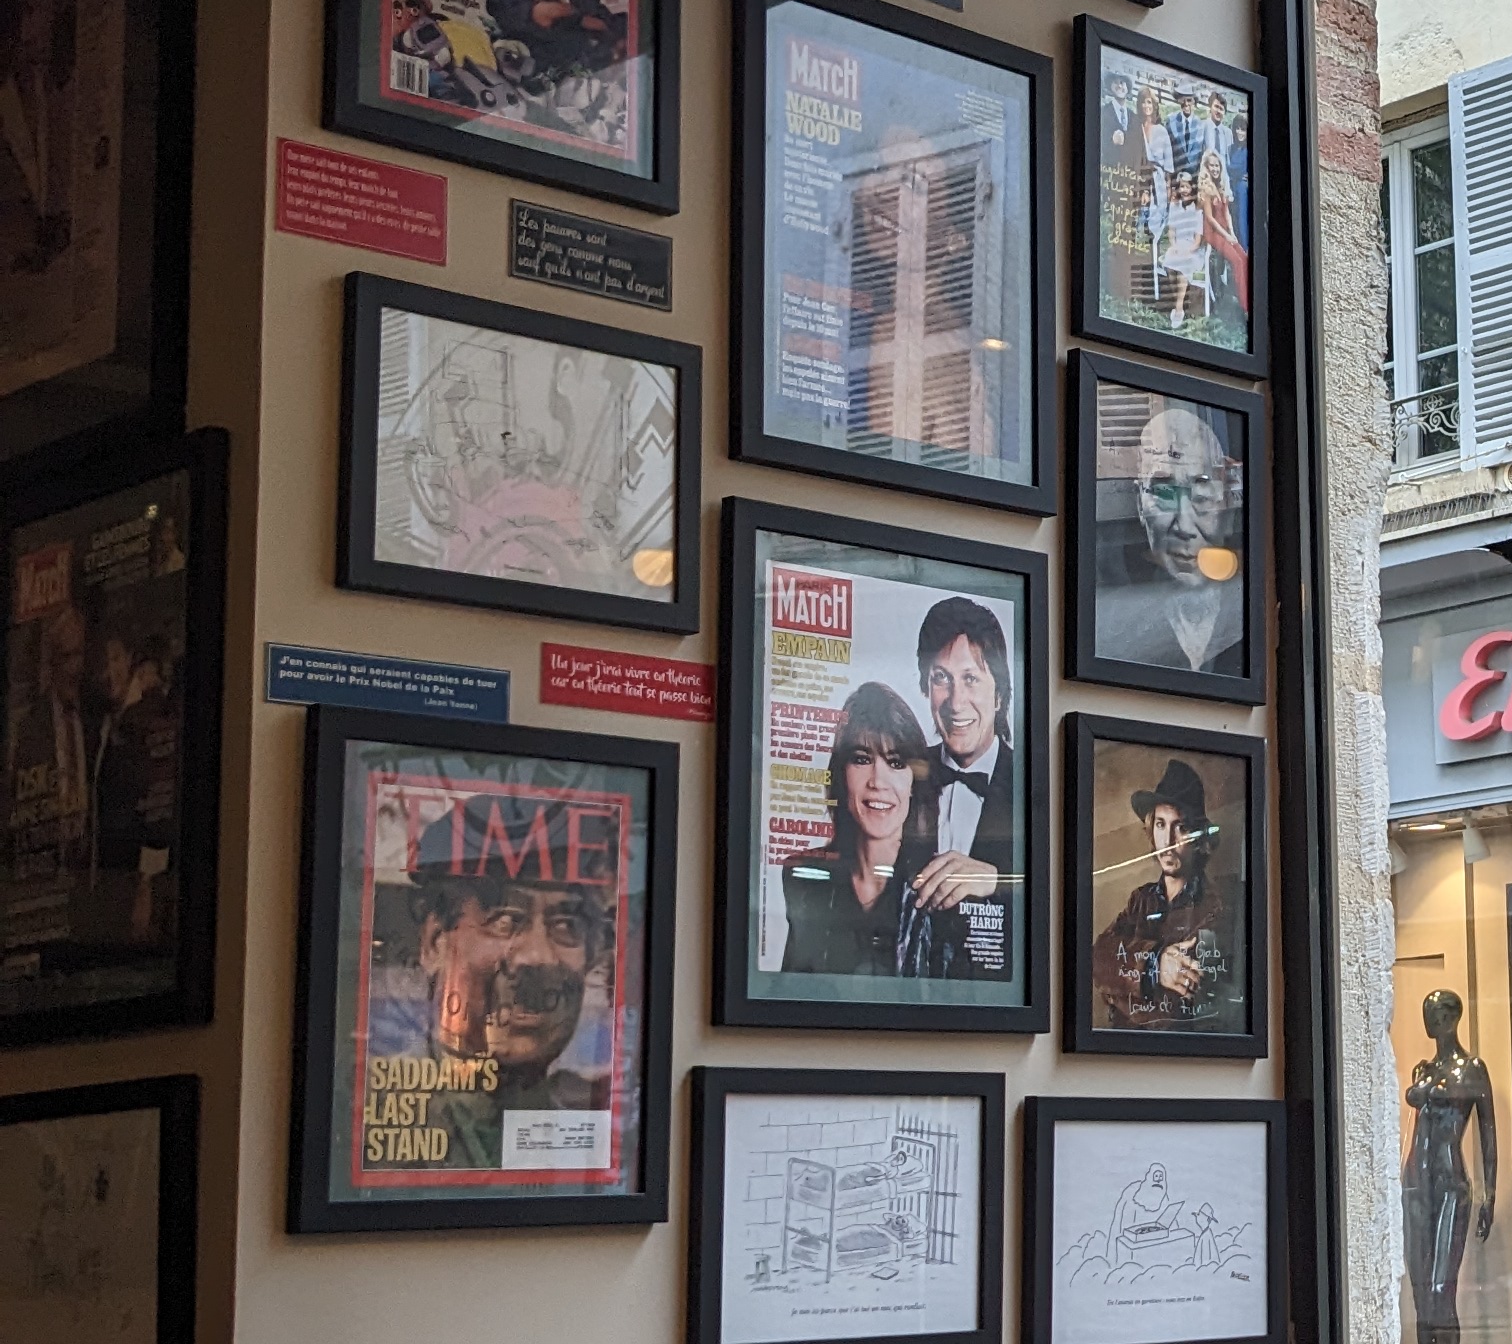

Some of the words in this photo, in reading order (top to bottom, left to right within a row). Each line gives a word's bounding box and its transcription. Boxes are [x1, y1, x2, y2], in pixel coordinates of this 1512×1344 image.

[790, 41, 858, 101] MATCH
[785, 112, 841, 145] WOOD
[786, 90, 862, 132] NATALIE
[518, 210, 539, 230] Les
[586, 232, 607, 246] sont
[518, 230, 536, 248] des
[567, 247, 604, 264] comme
[608, 258, 632, 271] nous
[605, 271, 622, 293] pas
[777, 575, 847, 630] MATCH
[771, 630, 851, 665] EMPAIN
[279, 655, 303, 667] J'en
[305, 660, 348, 673] connais
[350, 665, 367, 675] qui
[369, 667, 412, 680] seraient
[415, 672, 459, 686] capables
[462, 676, 474, 687] de
[477, 679, 498, 690] tuer
[279, 670, 304, 681] pour
[307, 672, 333, 684] avoir
[336, 674, 345, 684] le
[349, 675, 370, 688] Prix
[372, 676, 403, 690] Nobel
[405, 682, 418, 693] de
[420, 683, 430, 694] la
[432, 685, 455, 697] Paix
[551, 654, 568, 670] Un
[570, 657, 592, 677] jour
[625, 666, 650, 681] vivre
[653, 671, 666, 683] en
[667, 668, 701, 687] théorie
[551, 677, 569, 687] car
[572, 679, 585, 690] en
[586, 675, 622, 695] théorie
[622, 681, 647, 698] tout
[646, 688, 657, 699] se
[659, 690, 688, 704] passe
[690, 690, 711, 705] bien
[390, 792, 617, 887] TIME
[959, 902, 1004, 917] DUTRONC
[966, 916, 1004, 930] -HARDY
[371, 1057, 499, 1091] SADDAM'S
[368, 1091, 432, 1126] LAST
[367, 1127, 449, 1162] STAND
